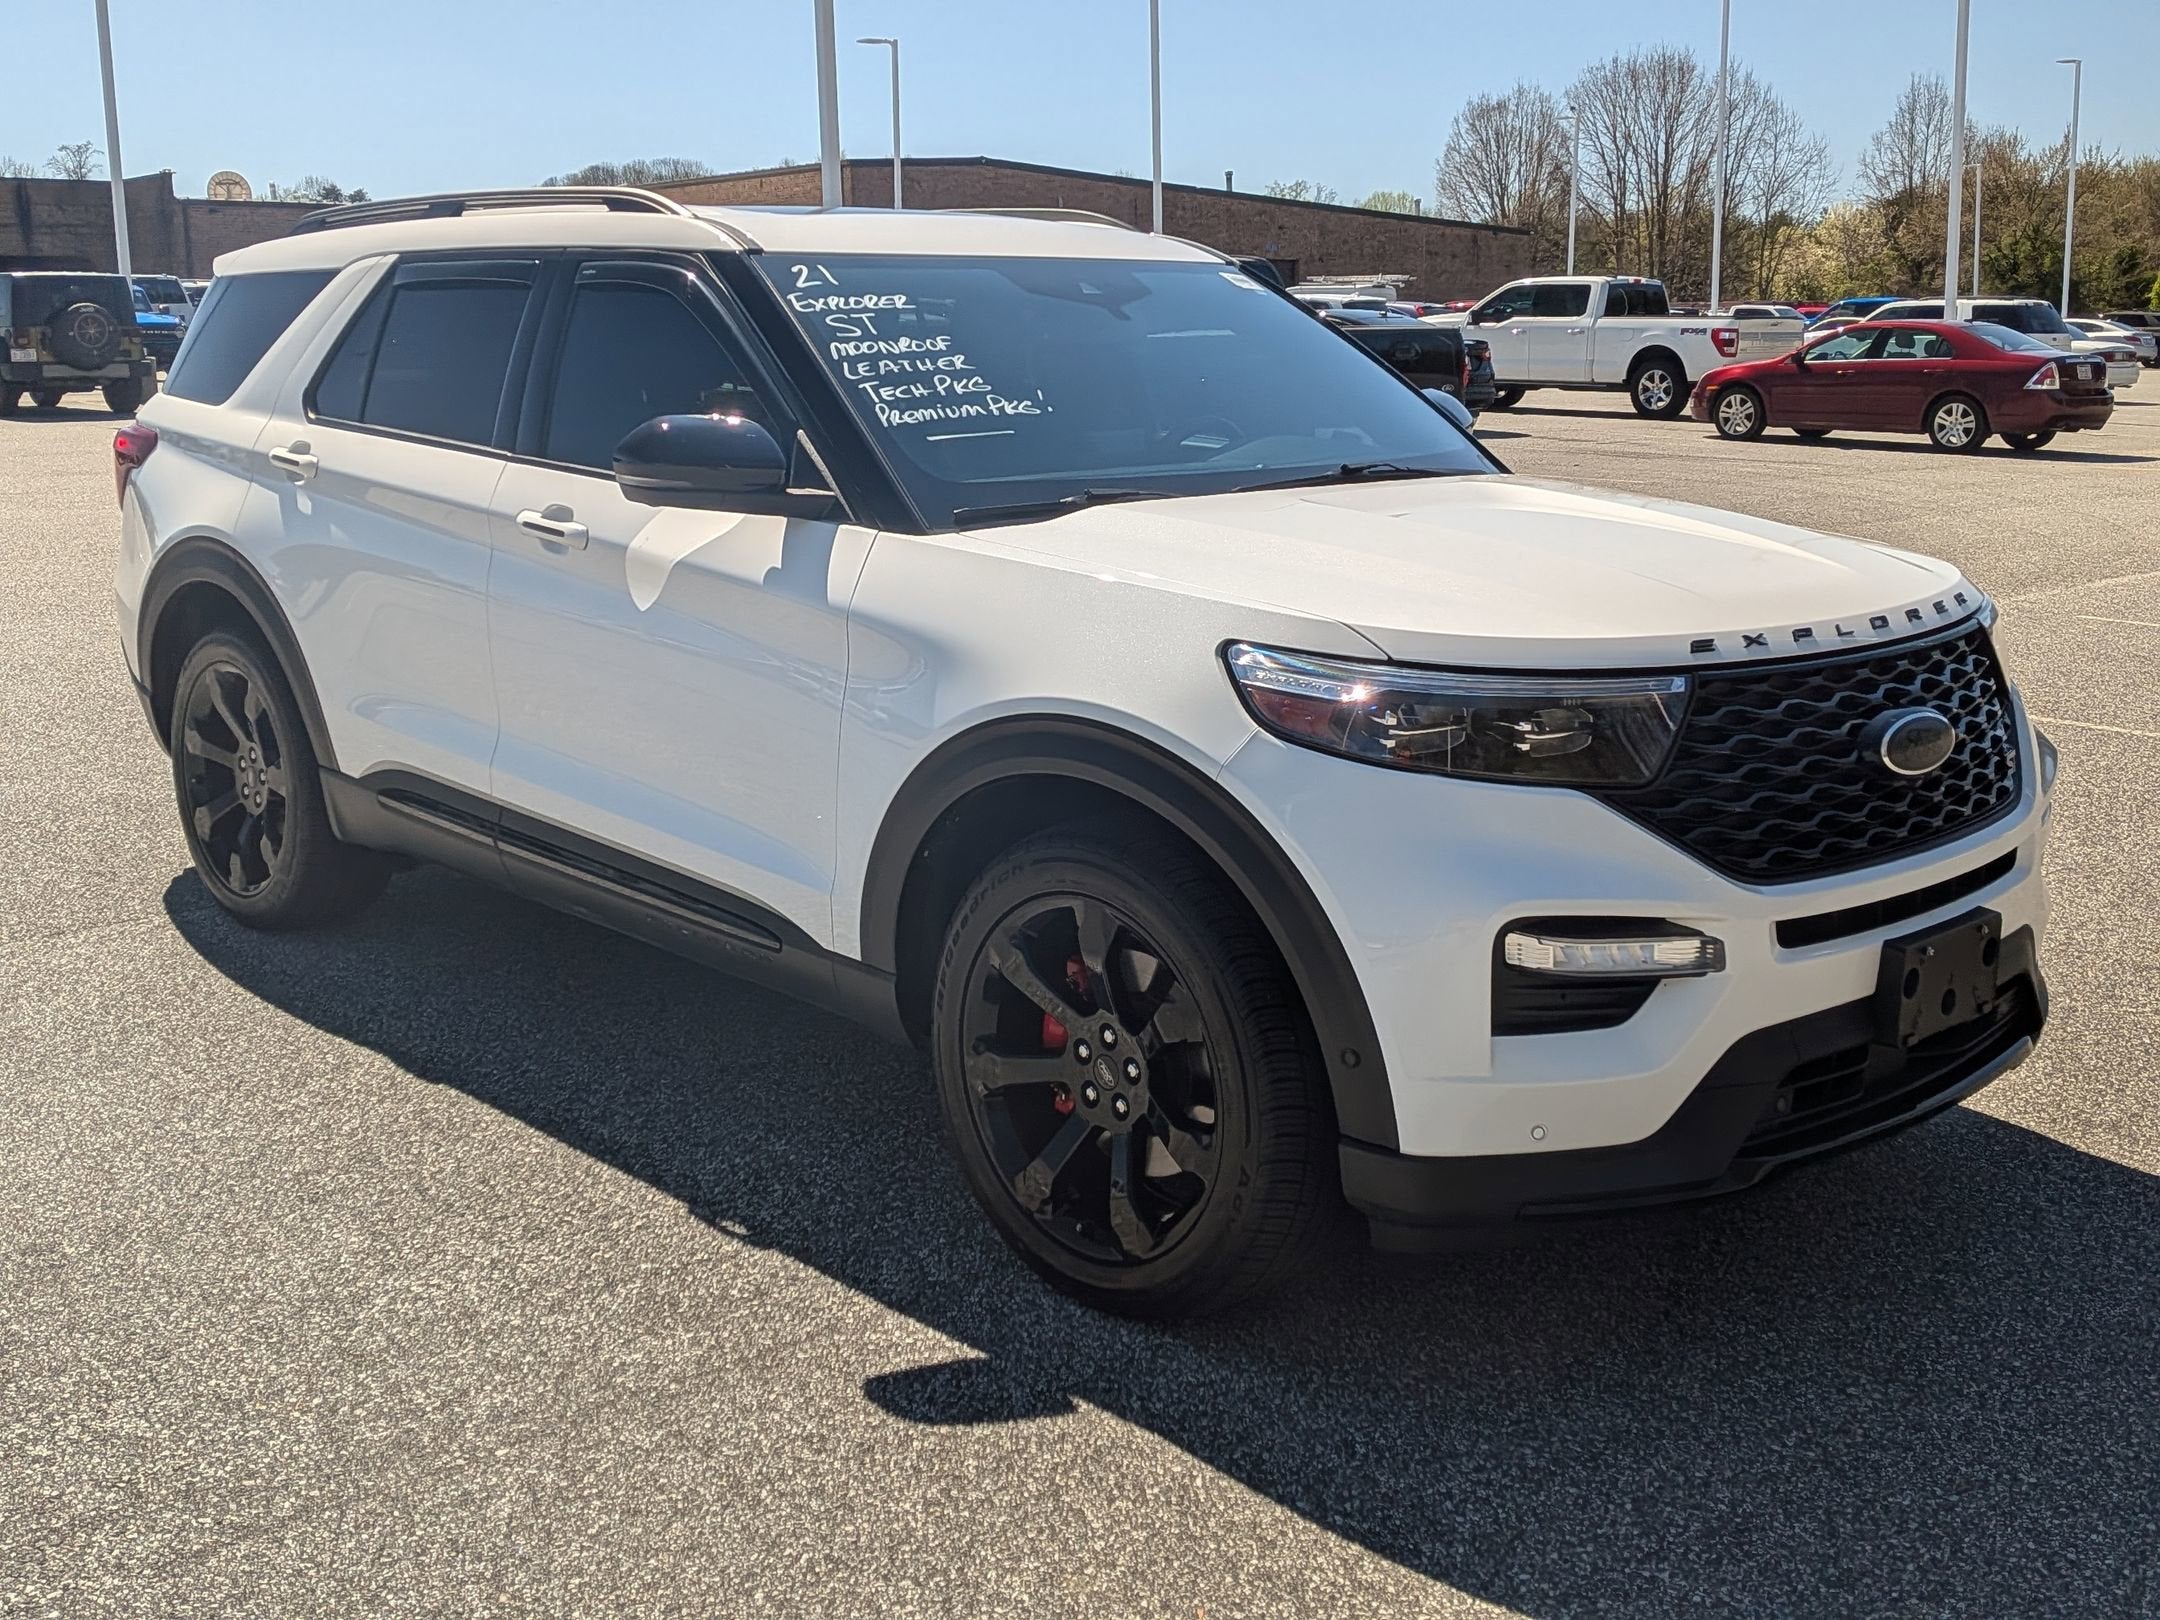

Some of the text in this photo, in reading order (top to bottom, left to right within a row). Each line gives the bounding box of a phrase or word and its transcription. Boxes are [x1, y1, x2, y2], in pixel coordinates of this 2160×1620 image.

[791, 265, 839, 288] 21
[787, 293, 917, 312] EXPLORER
[825, 313, 878, 336] ST
[1680, 327, 1707, 336] FX4
[830, 336, 951, 360] MOONROOF
[843, 354, 976, 380] LEATHER
[858, 374, 992, 403] TECH PKG
[1689, 591, 1969, 655] EXPLORER
